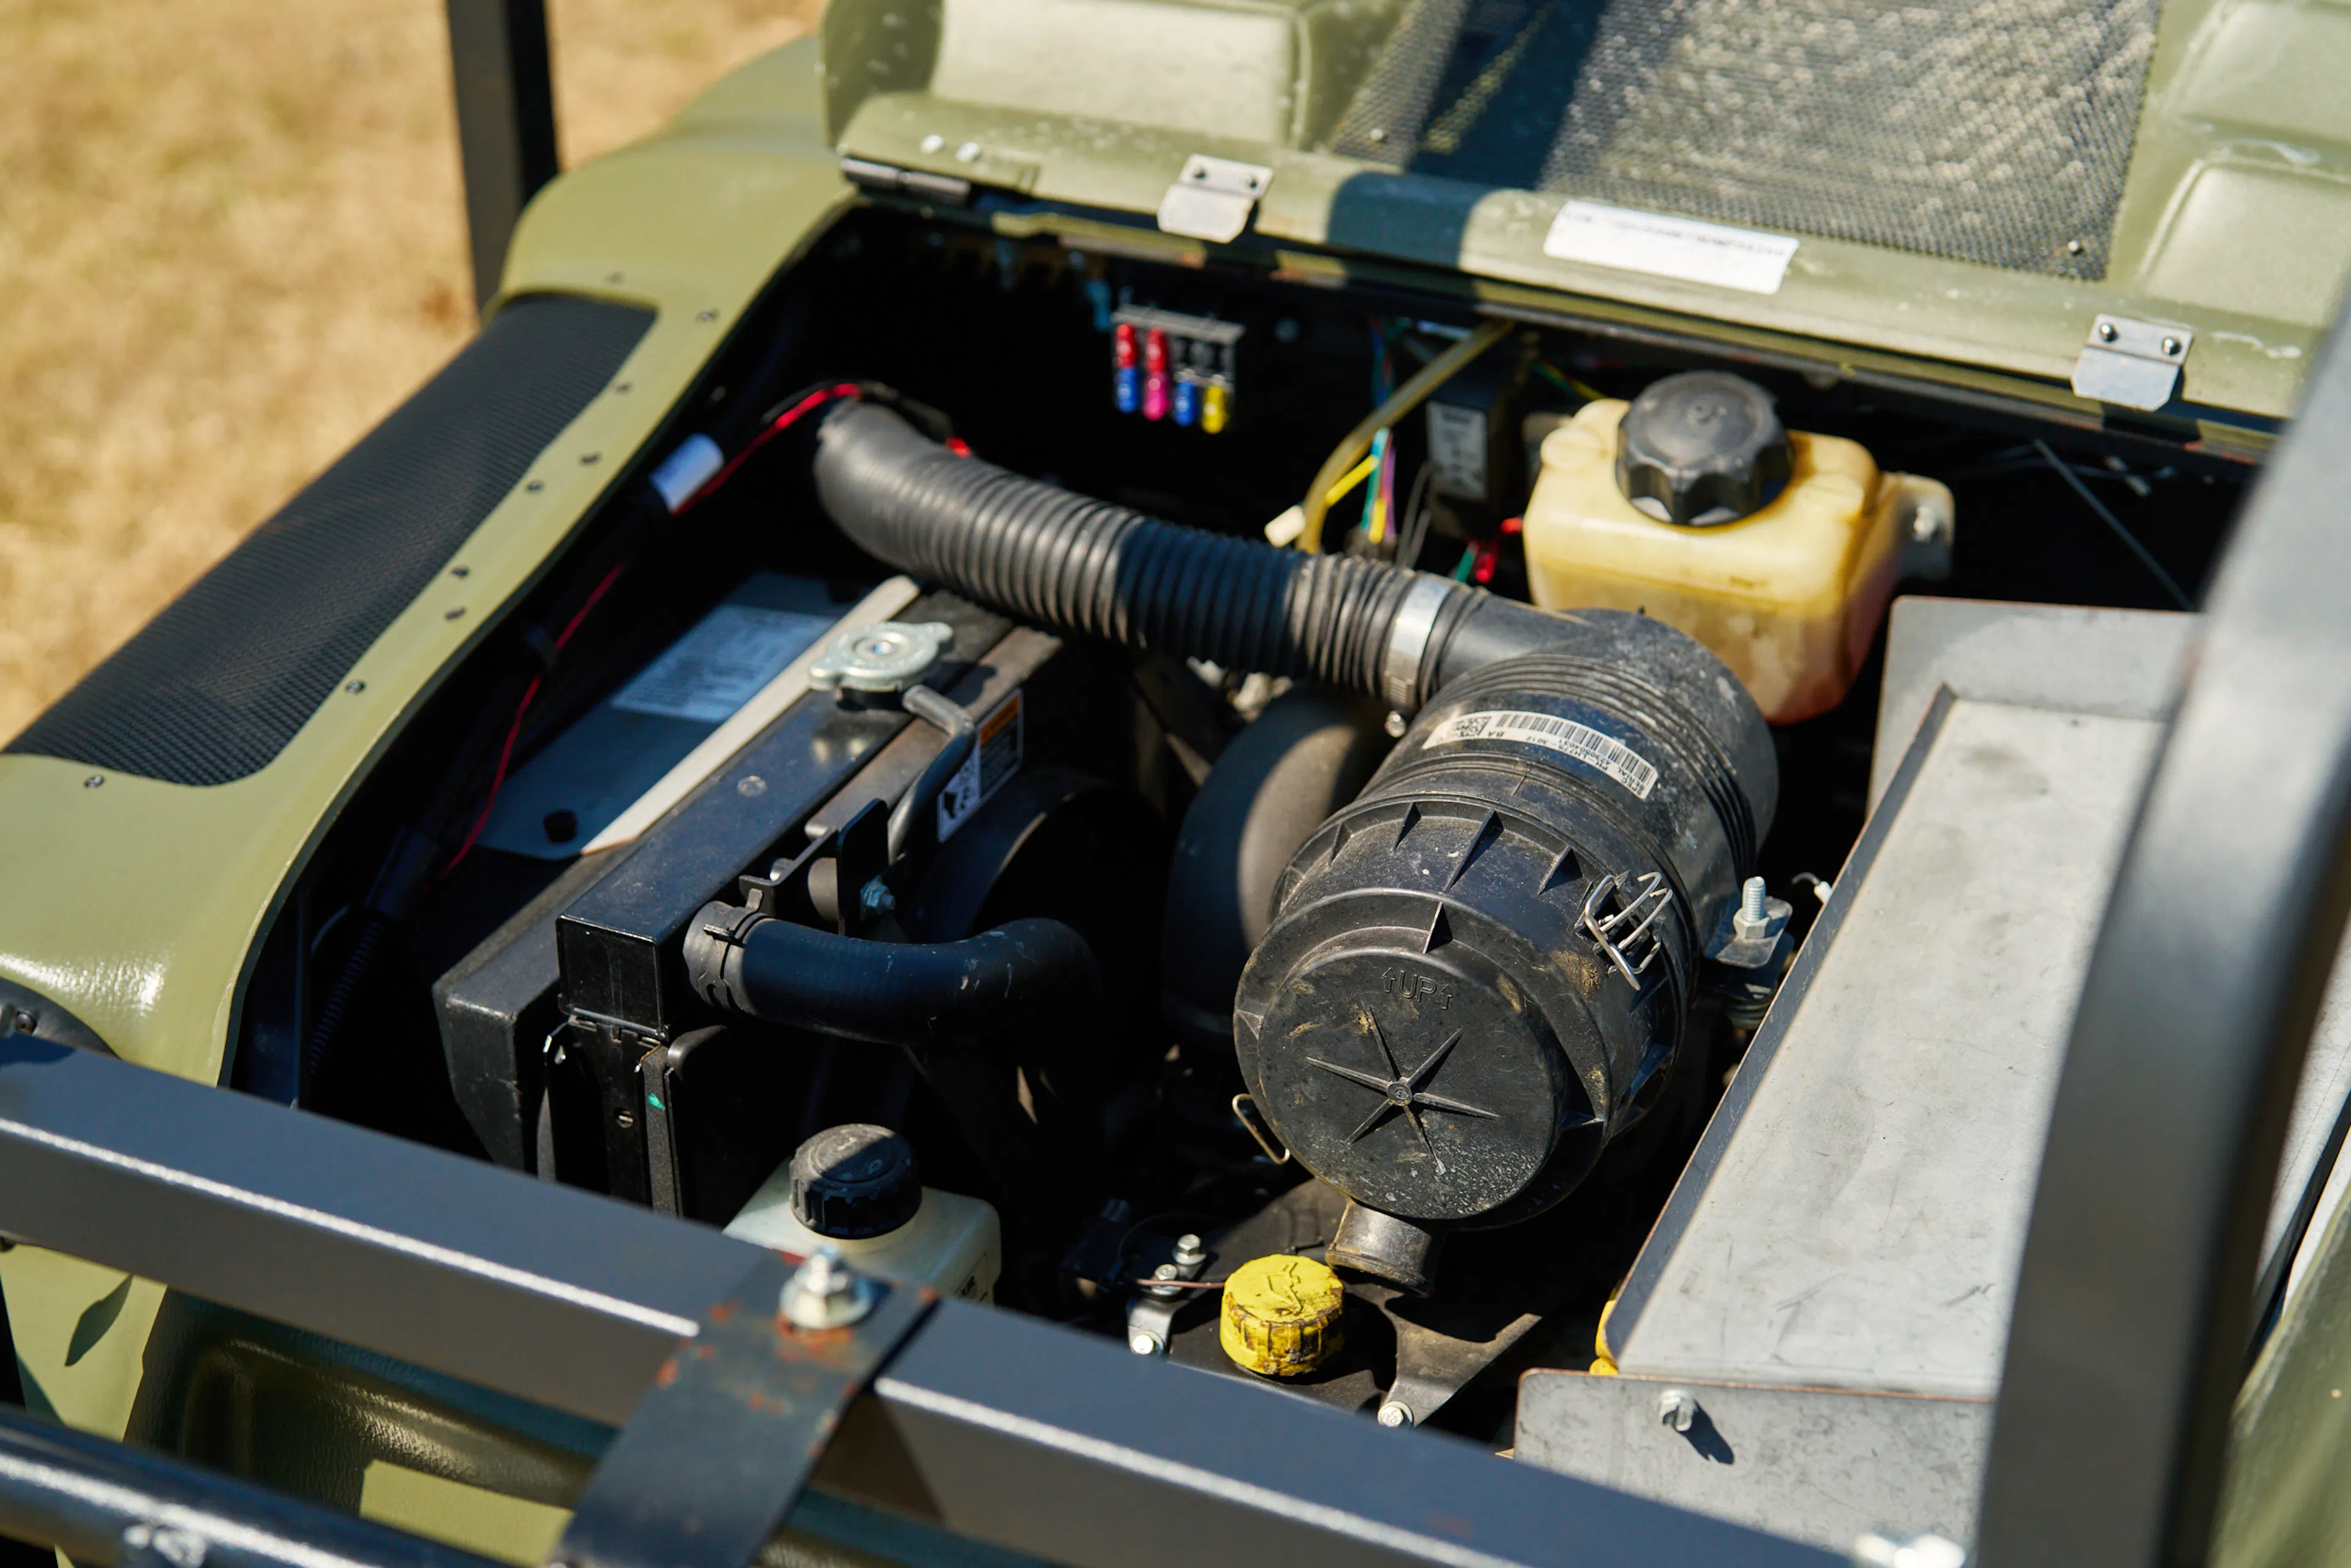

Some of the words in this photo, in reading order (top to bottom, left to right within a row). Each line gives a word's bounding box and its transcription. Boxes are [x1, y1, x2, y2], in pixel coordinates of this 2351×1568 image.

[1618, 766, 1645, 790] SERIAL
[1621, 776, 1643, 795] SPEC
[1399, 970, 1436, 1002] UP
